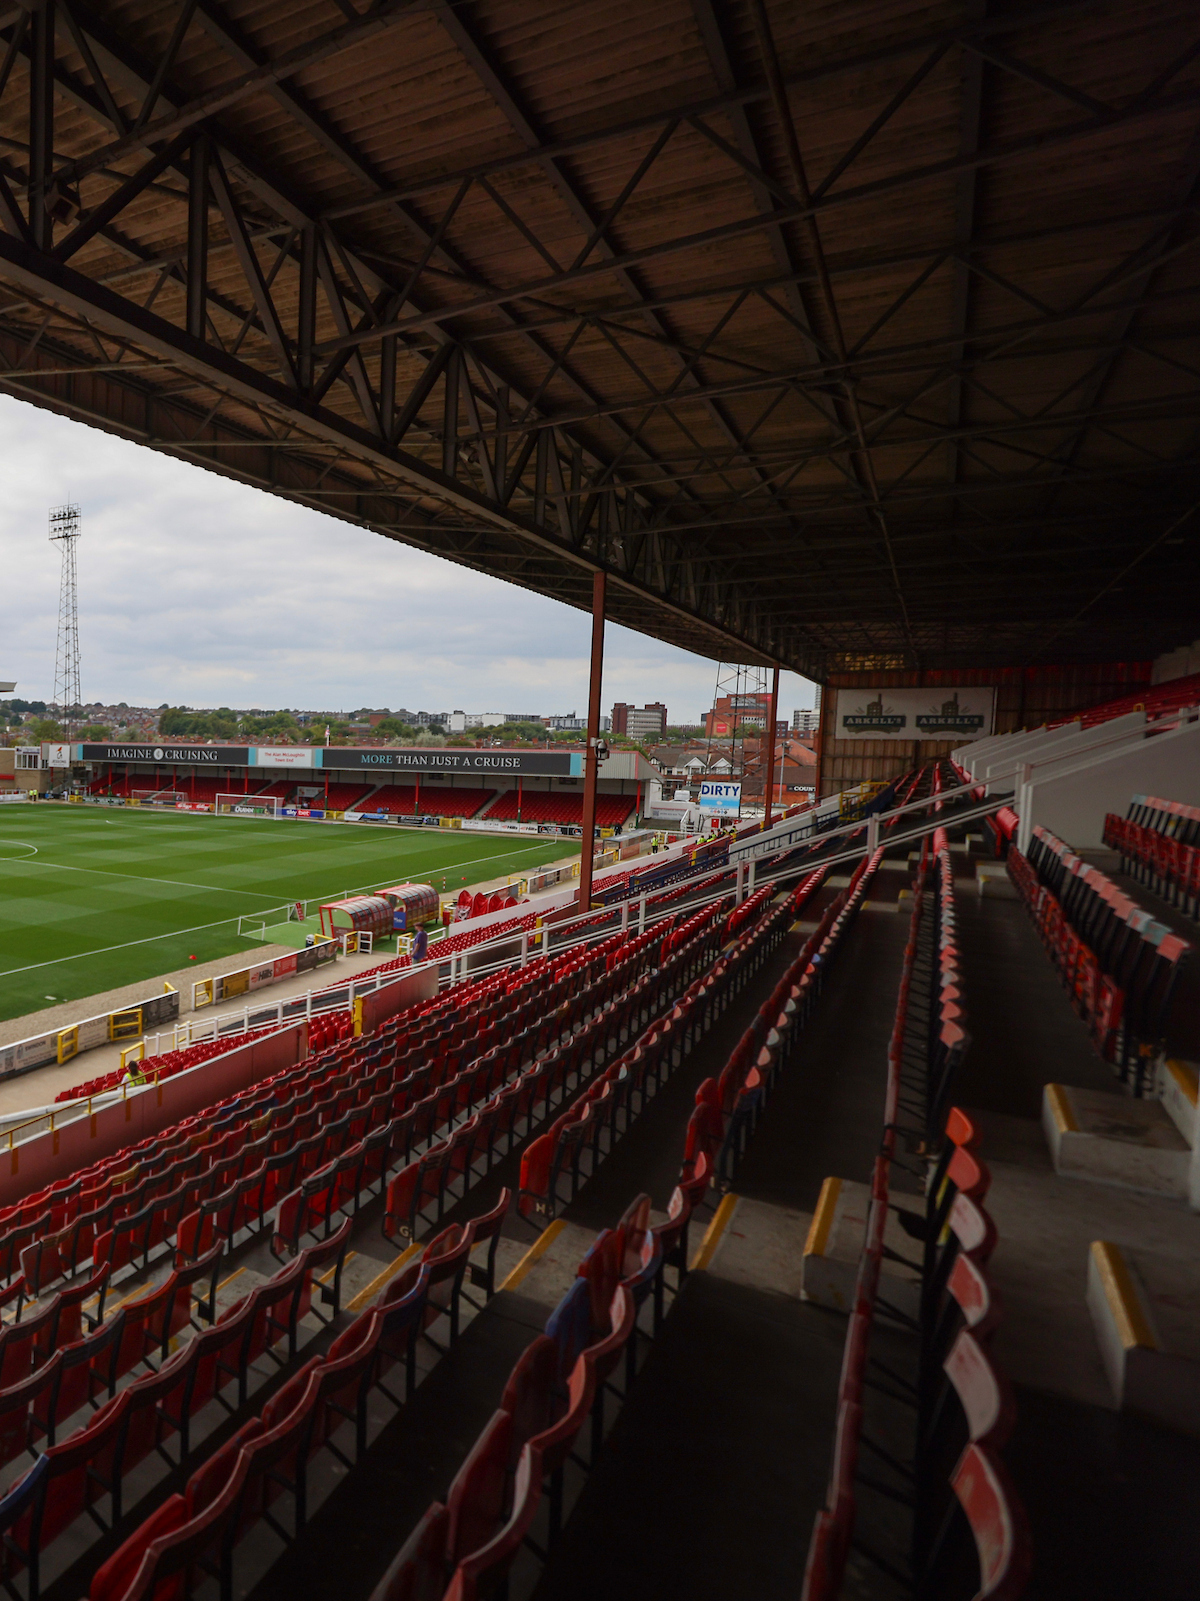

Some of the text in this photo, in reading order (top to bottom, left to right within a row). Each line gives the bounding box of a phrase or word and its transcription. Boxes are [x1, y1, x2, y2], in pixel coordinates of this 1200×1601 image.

[846, 717, 902, 725] ARKELL'S
[919, 717, 980, 725] ARKELL'S
[107, 748, 218, 761] IMAGINE CRUISING
[361, 755, 521, 768] MORE THAN JUST A CRUISE
[702, 785, 740, 796] DIRTY
[258, 969, 272, 981] Hills
[399, 1225, 409, 1237] G
